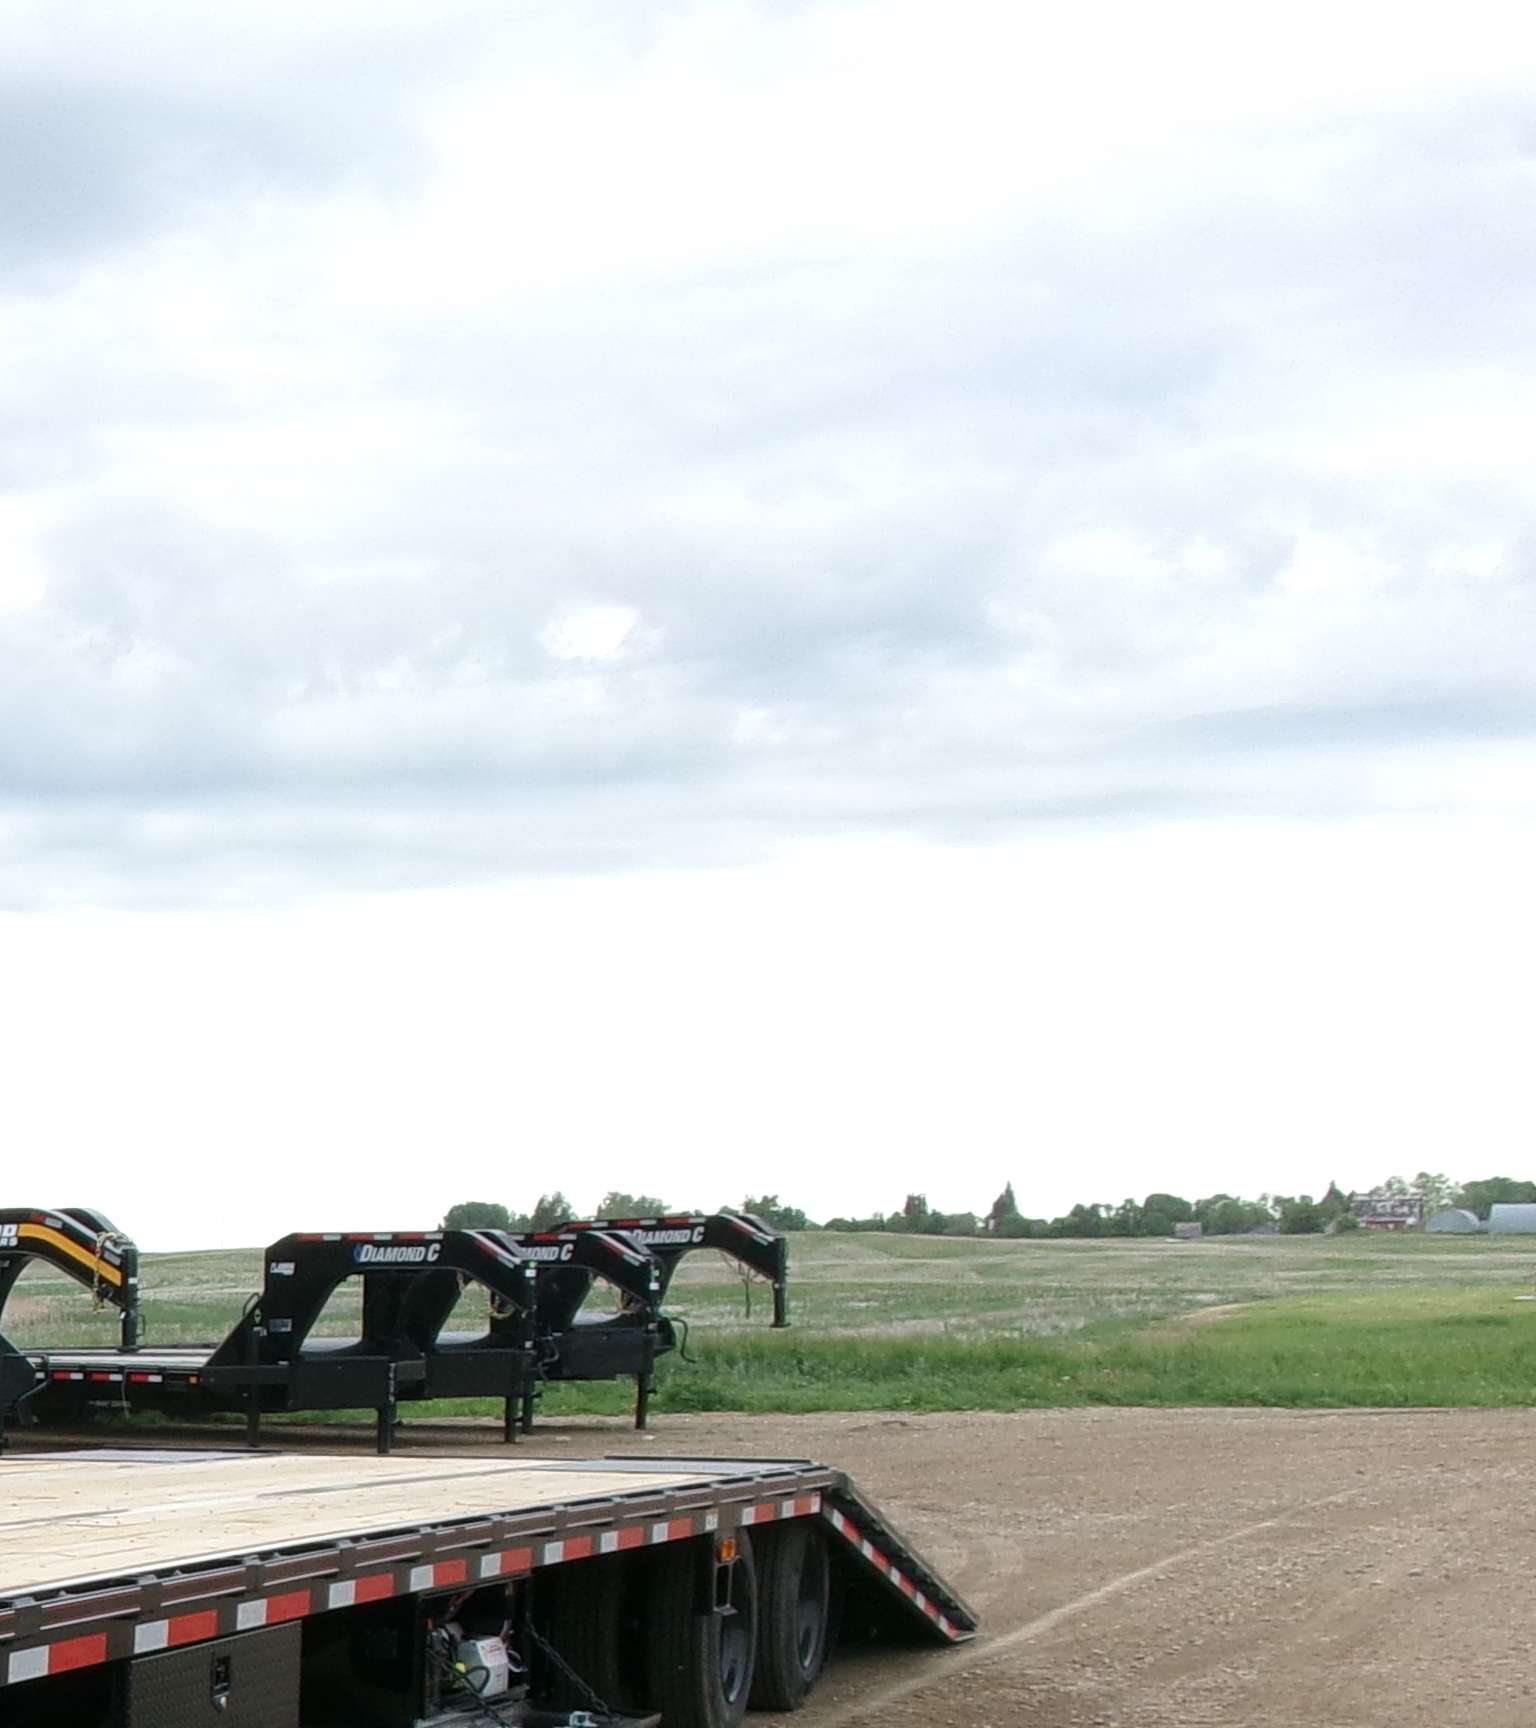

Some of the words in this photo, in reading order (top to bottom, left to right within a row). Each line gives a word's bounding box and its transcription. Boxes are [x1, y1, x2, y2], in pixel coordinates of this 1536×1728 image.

[692, 1226, 705, 1243] C
[359, 1244, 426, 1263] DIAMOND
[426, 1243, 441, 1262] C
[560, 1243, 575, 1261] C
